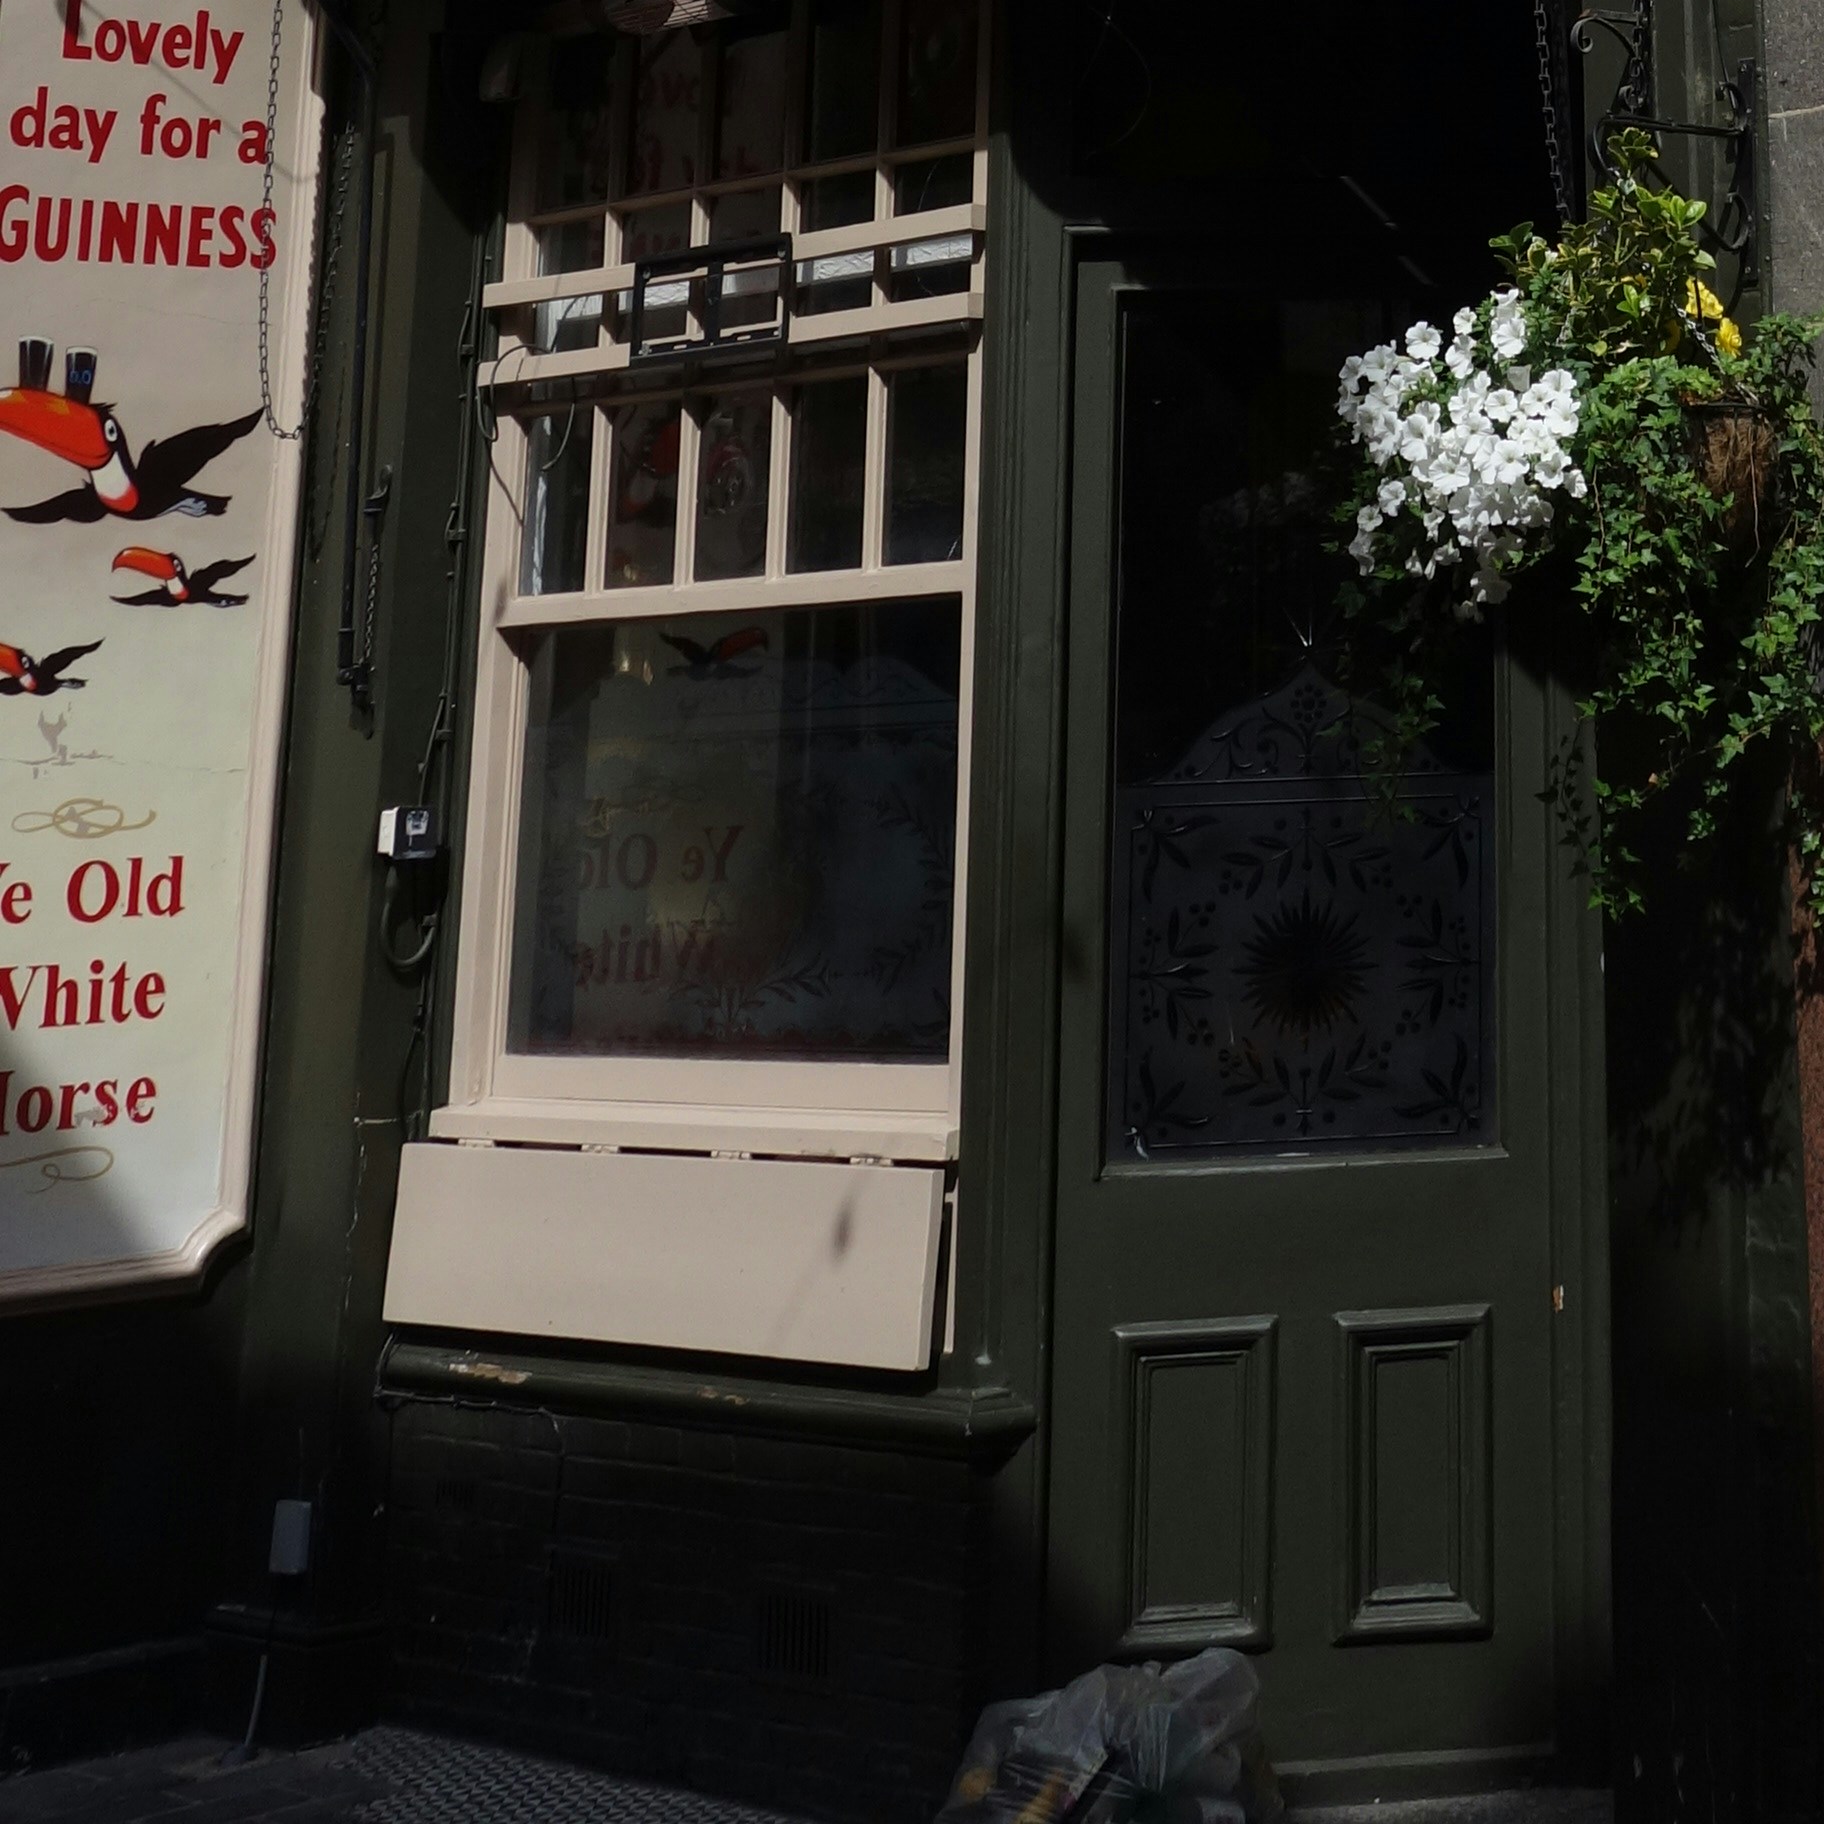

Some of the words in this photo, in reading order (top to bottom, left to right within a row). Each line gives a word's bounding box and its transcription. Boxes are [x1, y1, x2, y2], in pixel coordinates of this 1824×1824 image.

[10, 86, 118, 163] day
[140, 93, 221, 158] for
[238, 120, 269, 165] a
[0, 184, 277, 269] GUINNESS
[66, 855, 185, 923] Old
